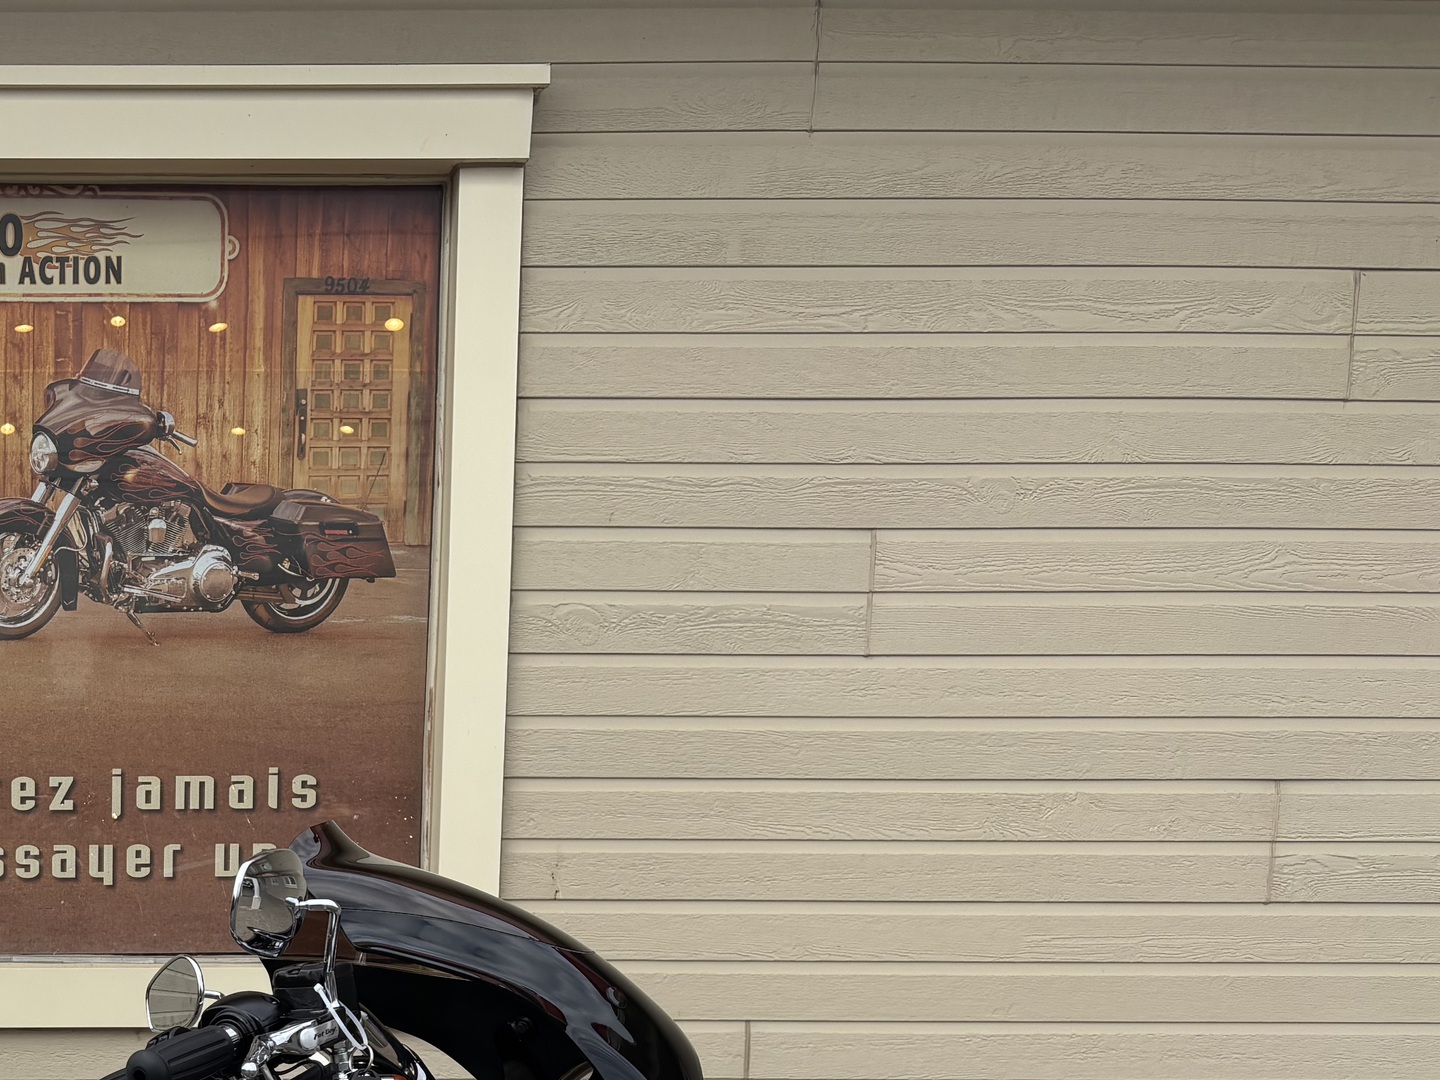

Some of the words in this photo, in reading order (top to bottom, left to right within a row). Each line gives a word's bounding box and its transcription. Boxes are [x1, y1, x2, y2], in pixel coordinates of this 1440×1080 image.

[18, 255, 123, 286] ACTION
[324, 276, 371, 293] 9504
[111, 766, 318, 820] jamais
